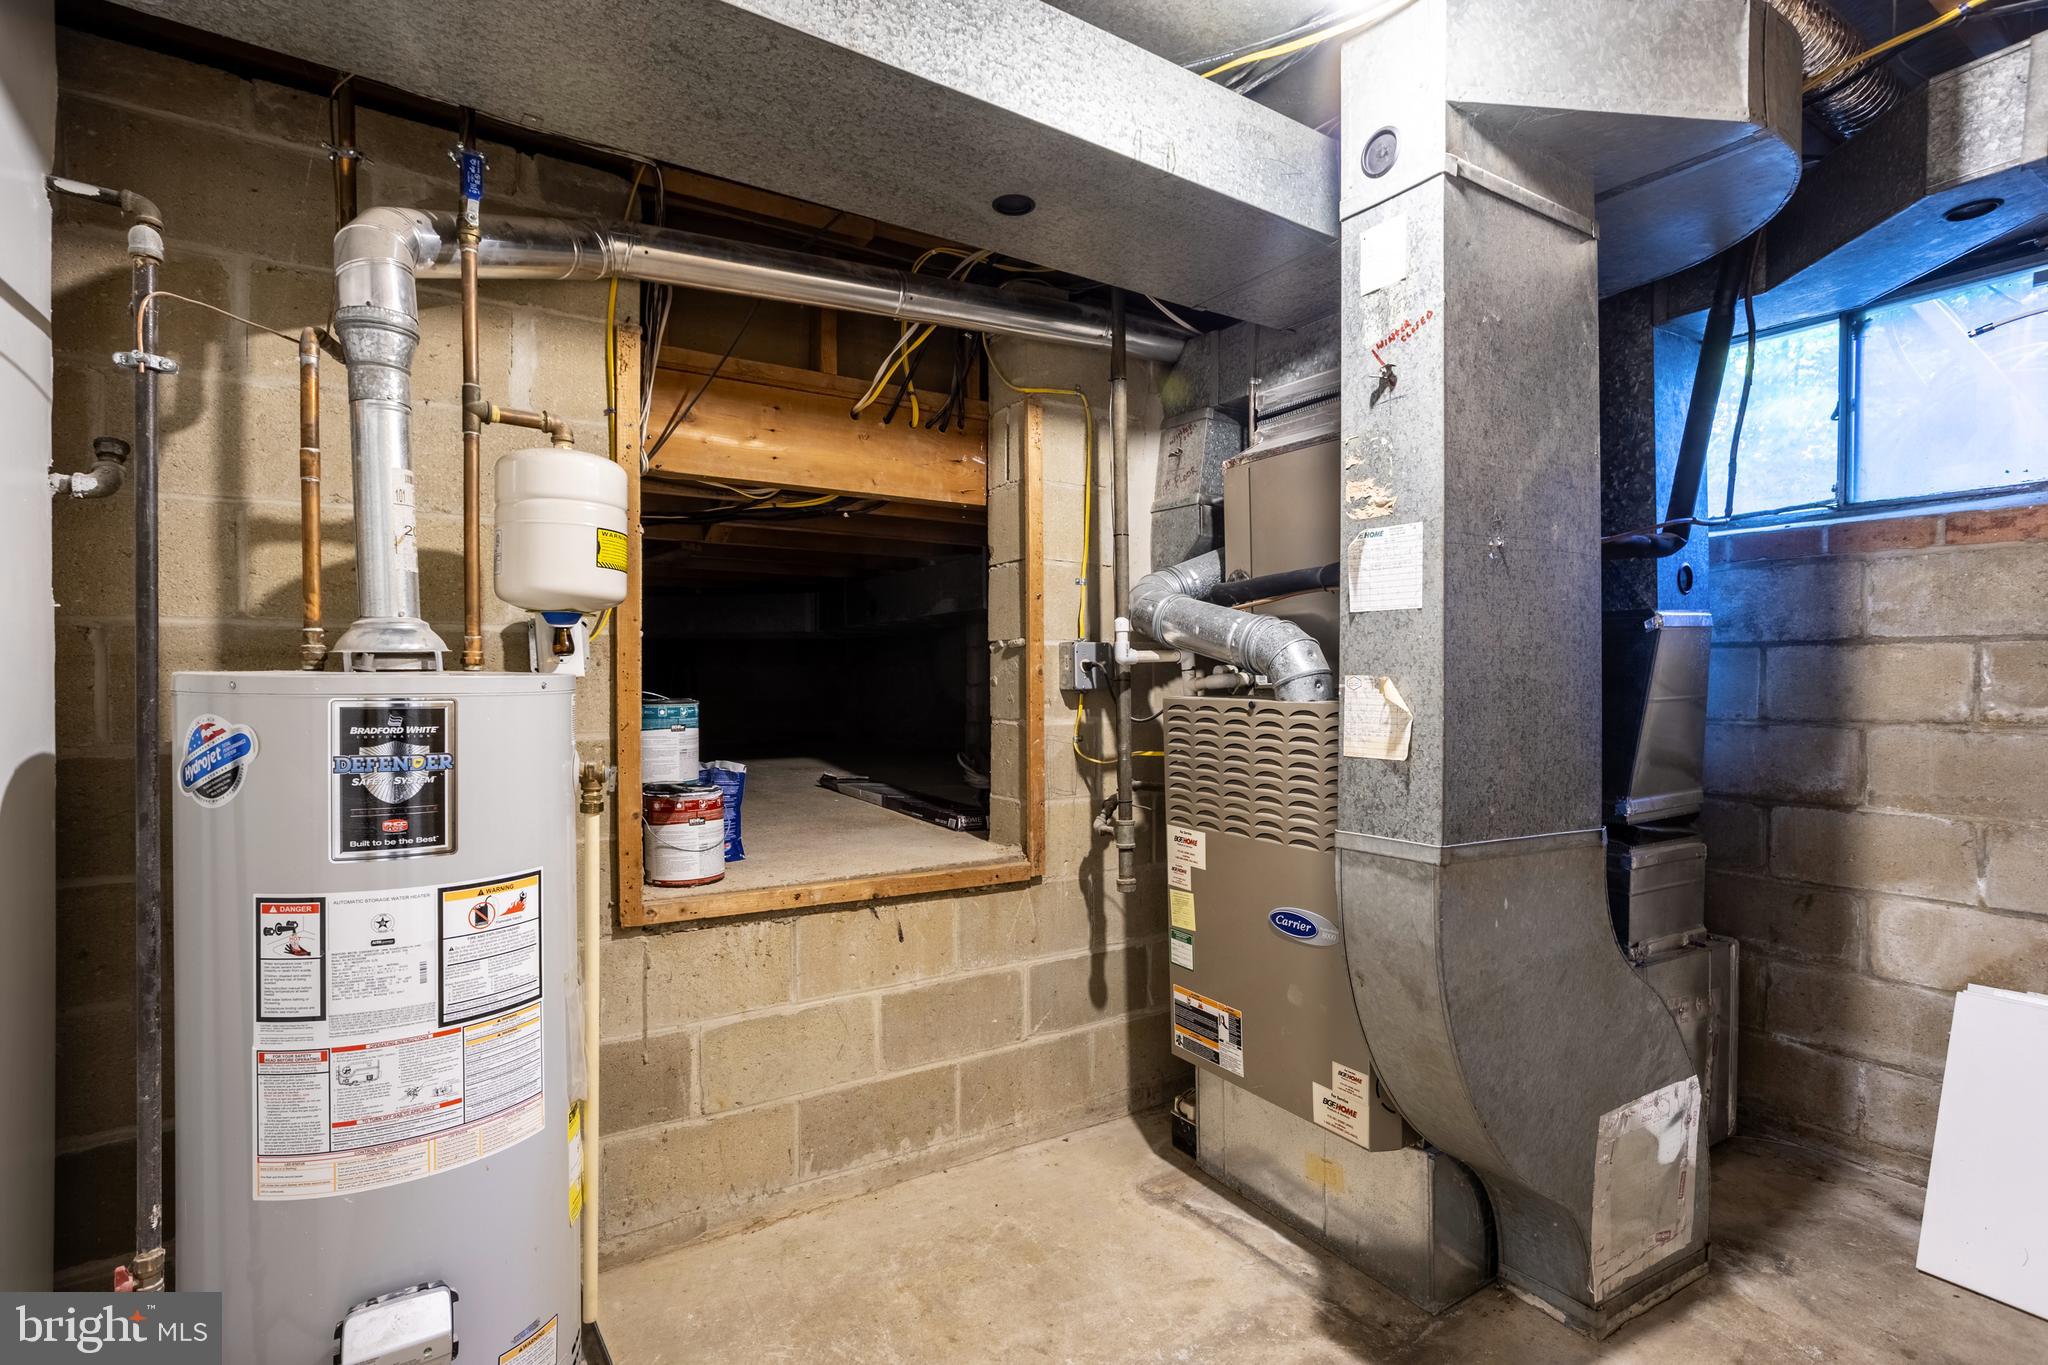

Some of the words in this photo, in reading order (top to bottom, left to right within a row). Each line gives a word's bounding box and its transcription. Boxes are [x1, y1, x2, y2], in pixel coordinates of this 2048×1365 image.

[350, 726, 404, 735] BRADFORD
[406, 725, 439, 734] WHITE
[185, 747, 222, 781] Hydrojet
[333, 753, 454, 774] DEFENDER
[350, 840, 370, 848] Built
[416, 835, 437, 844] Best
[486, 883, 514, 894] WARNING
[280, 905, 312, 913] DANGER
[1275, 914, 1312, 932] Carrier
